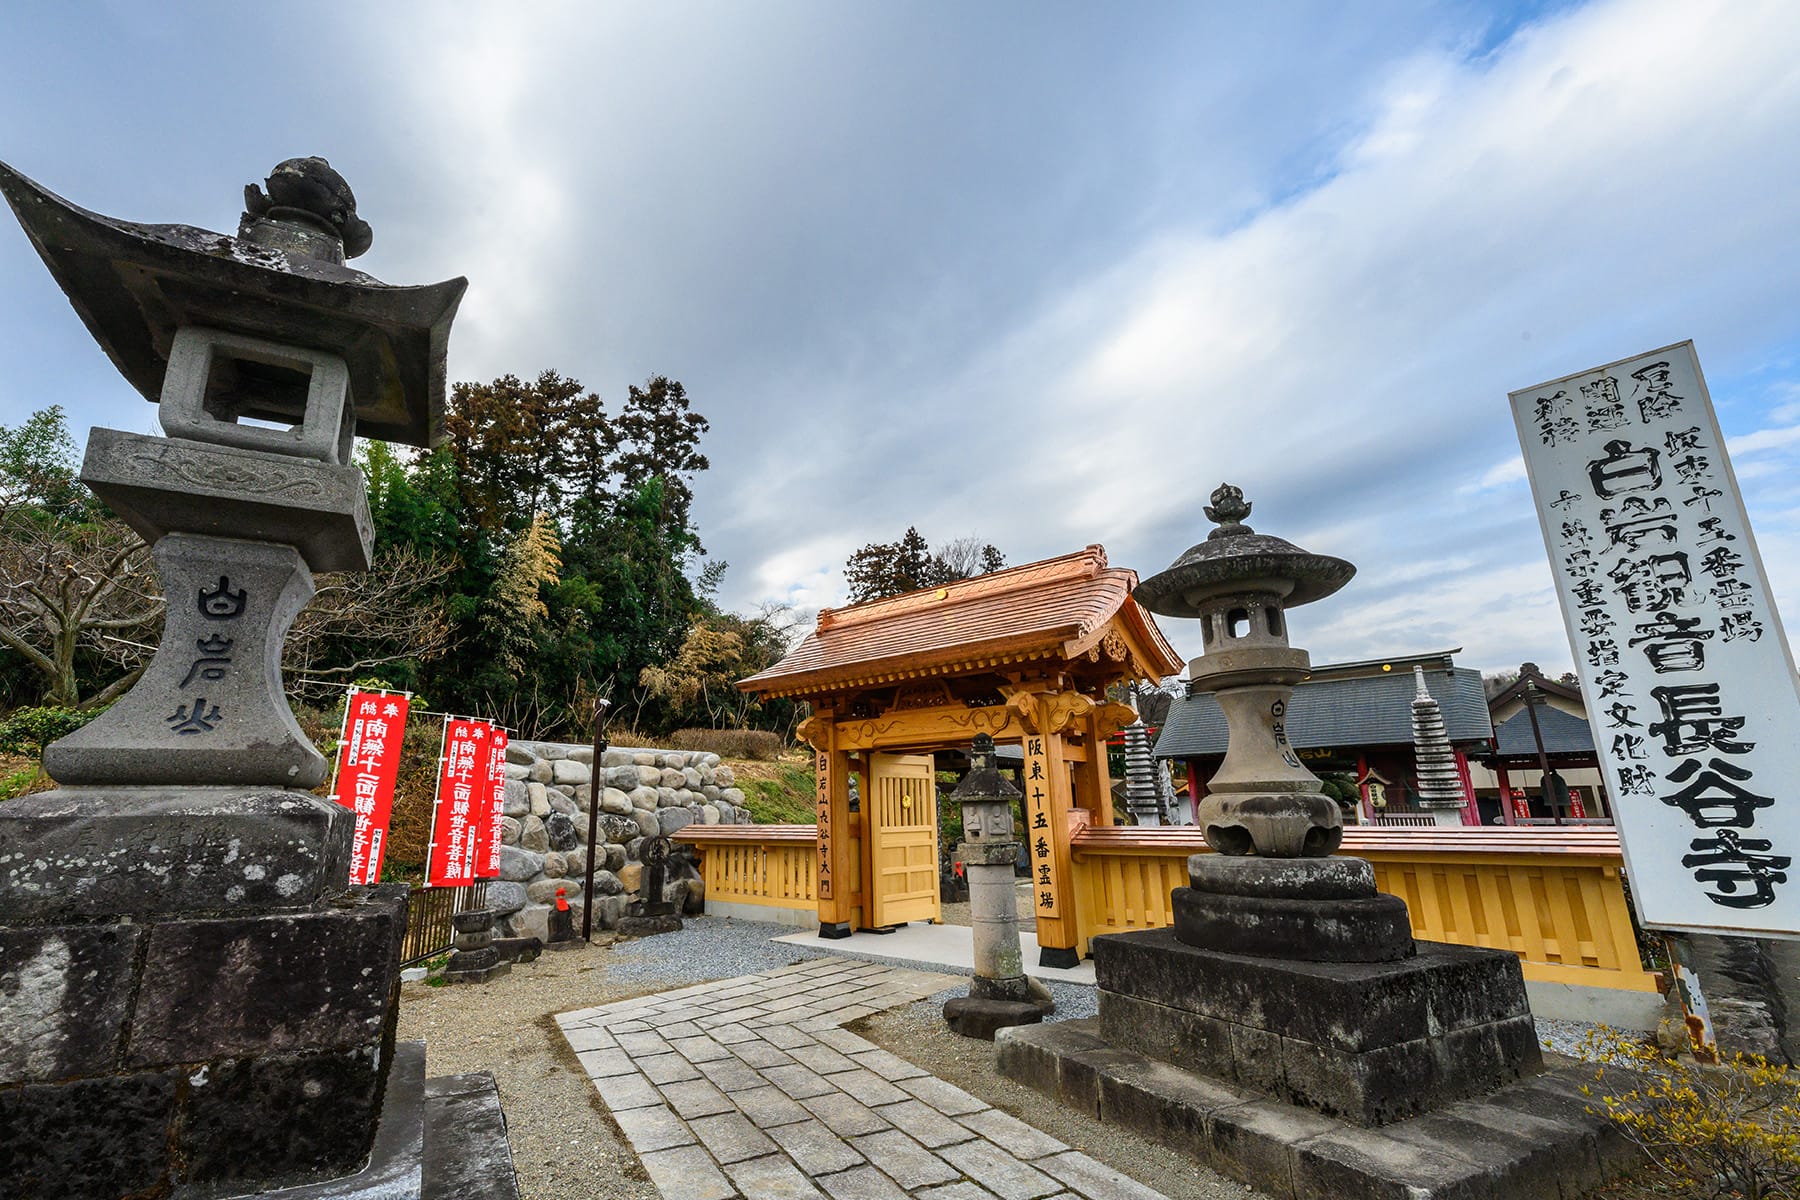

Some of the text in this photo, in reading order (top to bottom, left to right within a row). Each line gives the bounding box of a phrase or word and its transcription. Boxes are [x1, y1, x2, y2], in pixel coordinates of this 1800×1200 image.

[818, 755, 831, 893] 白岩山長谷寺大門
[1028, 738, 1054, 909] 阪東十五番霊場
